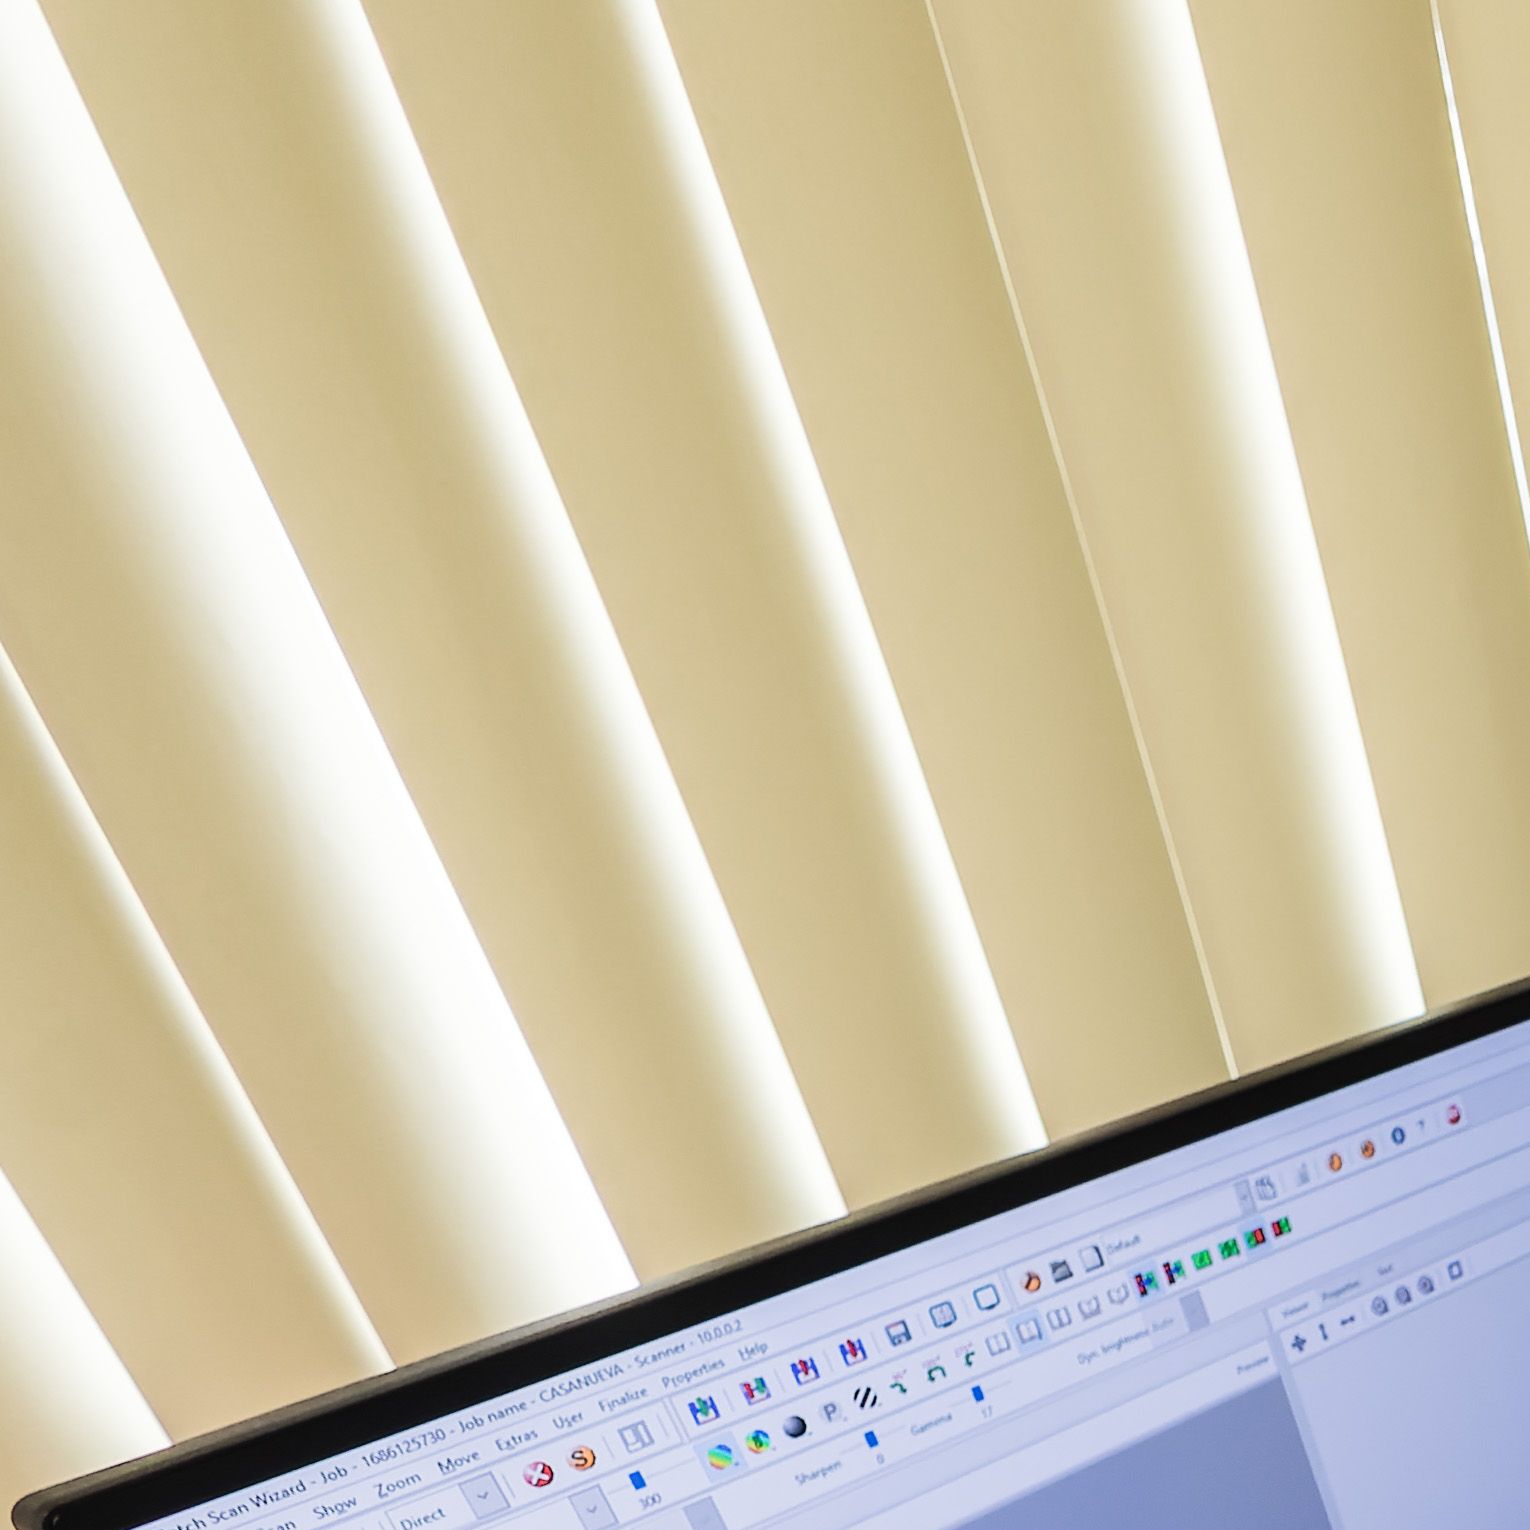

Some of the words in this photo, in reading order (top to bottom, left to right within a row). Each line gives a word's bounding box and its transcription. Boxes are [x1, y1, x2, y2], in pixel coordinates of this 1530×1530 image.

[207, 1503, 249, 1525] Scan
[249, 1480, 307, 1510] Wizard
[322, 1465, 348, 1486] Job
[362, 1427, 446, 1467] 1686125730
[459, 1415, 485, 1434] Job
[488, 1402, 528, 1423] name
[539, 1363, 624, 1403] CASANUEVA
[634, 1344, 687, 1369] Scanner
[312, 1497, 358, 1520] Show
[376, 1473, 422, 1499] Zoom
[436, 1449, 481, 1475] Move
[495, 1428, 538, 1452] Extras
[552, 1410, 584, 1431] User
[598, 1386, 648, 1413] Finalize
[661, 1357, 726, 1390] Properties
[738, 1341, 769, 1363] Help
[794, 1459, 843, 1487] Sharpen
